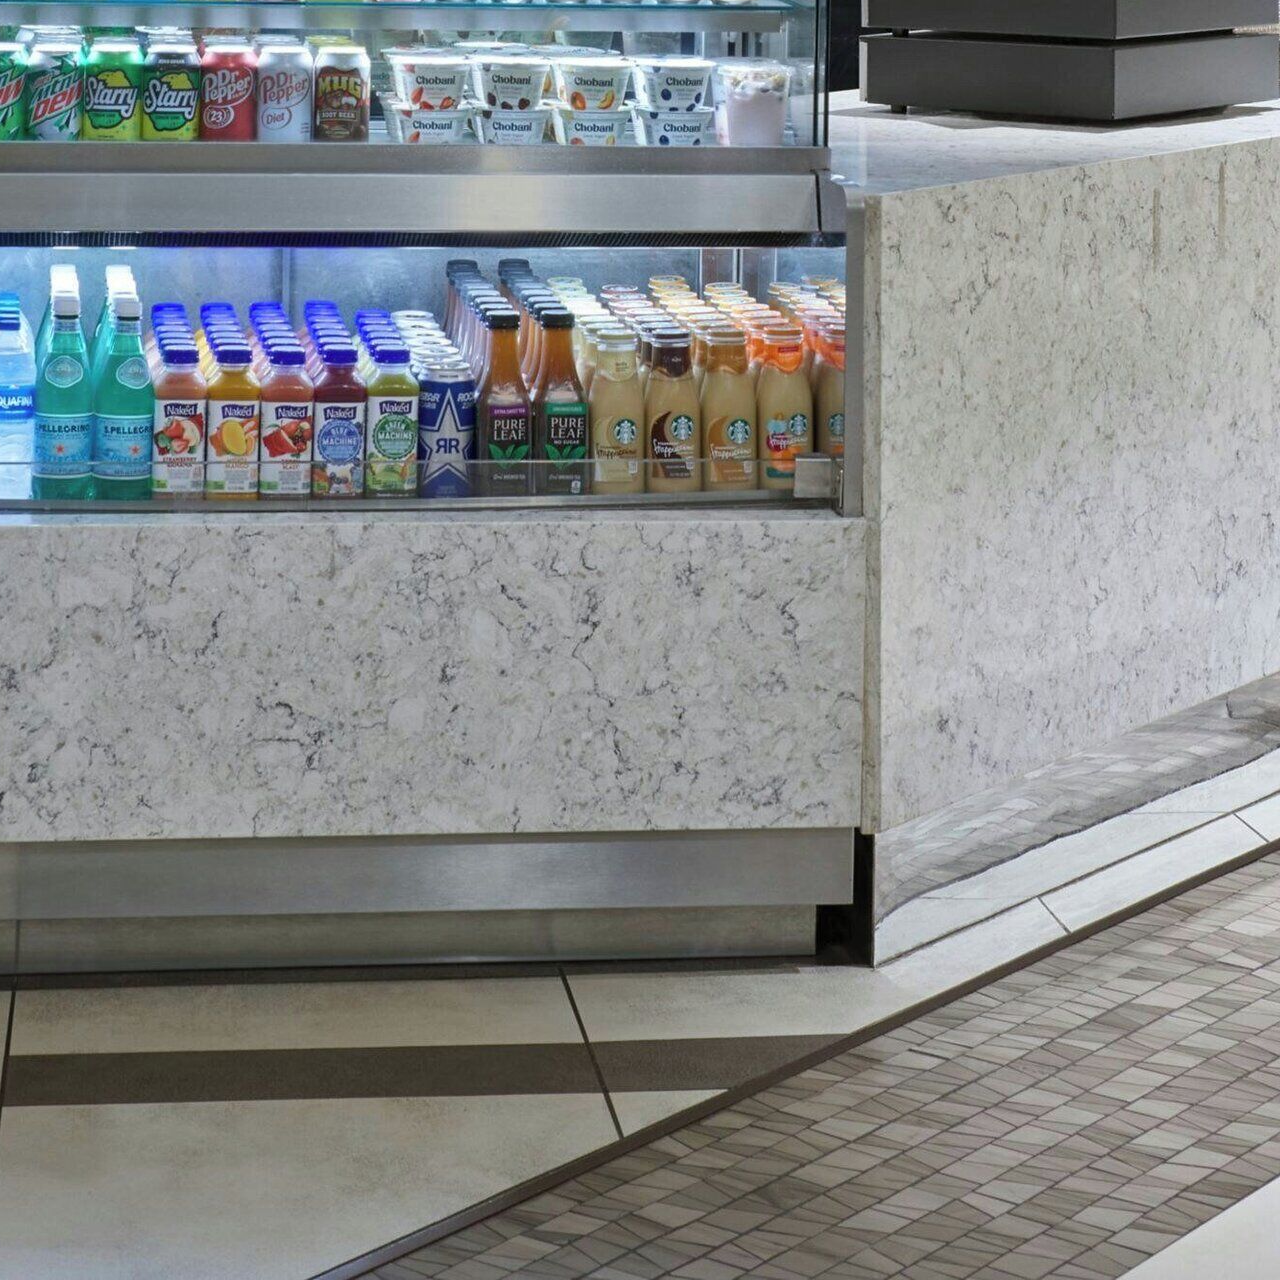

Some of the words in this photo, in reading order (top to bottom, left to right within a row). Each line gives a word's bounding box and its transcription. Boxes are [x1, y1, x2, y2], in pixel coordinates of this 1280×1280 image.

[217, 69, 239, 86] Dr
[275, 71, 296, 88] Dr
[415, 75, 456, 85] Chobani
[491, 75, 532, 85] Chobani
[573, 76, 614, 87] Chobani
[202, 73, 251, 103] Pepper
[261, 76, 308, 104] Pepper
[317, 76, 361, 98] MUG
[85, 76, 138, 118] Starry
[144, 79, 198, 120] Starry
[266, 113, 285, 124] Diet
[412, 120, 453, 130] Chobani
[492, 121, 533, 131] Chobani
[574, 122, 614, 132] Chobani
[494, 418, 526, 430] PURE
[551, 417, 585, 428] PURE
[379, 431, 412, 440] MACHINE
[494, 429, 526, 440] LEAF
[551, 428, 584, 439] LEAF
[322, 437, 357, 445] MACHINE
